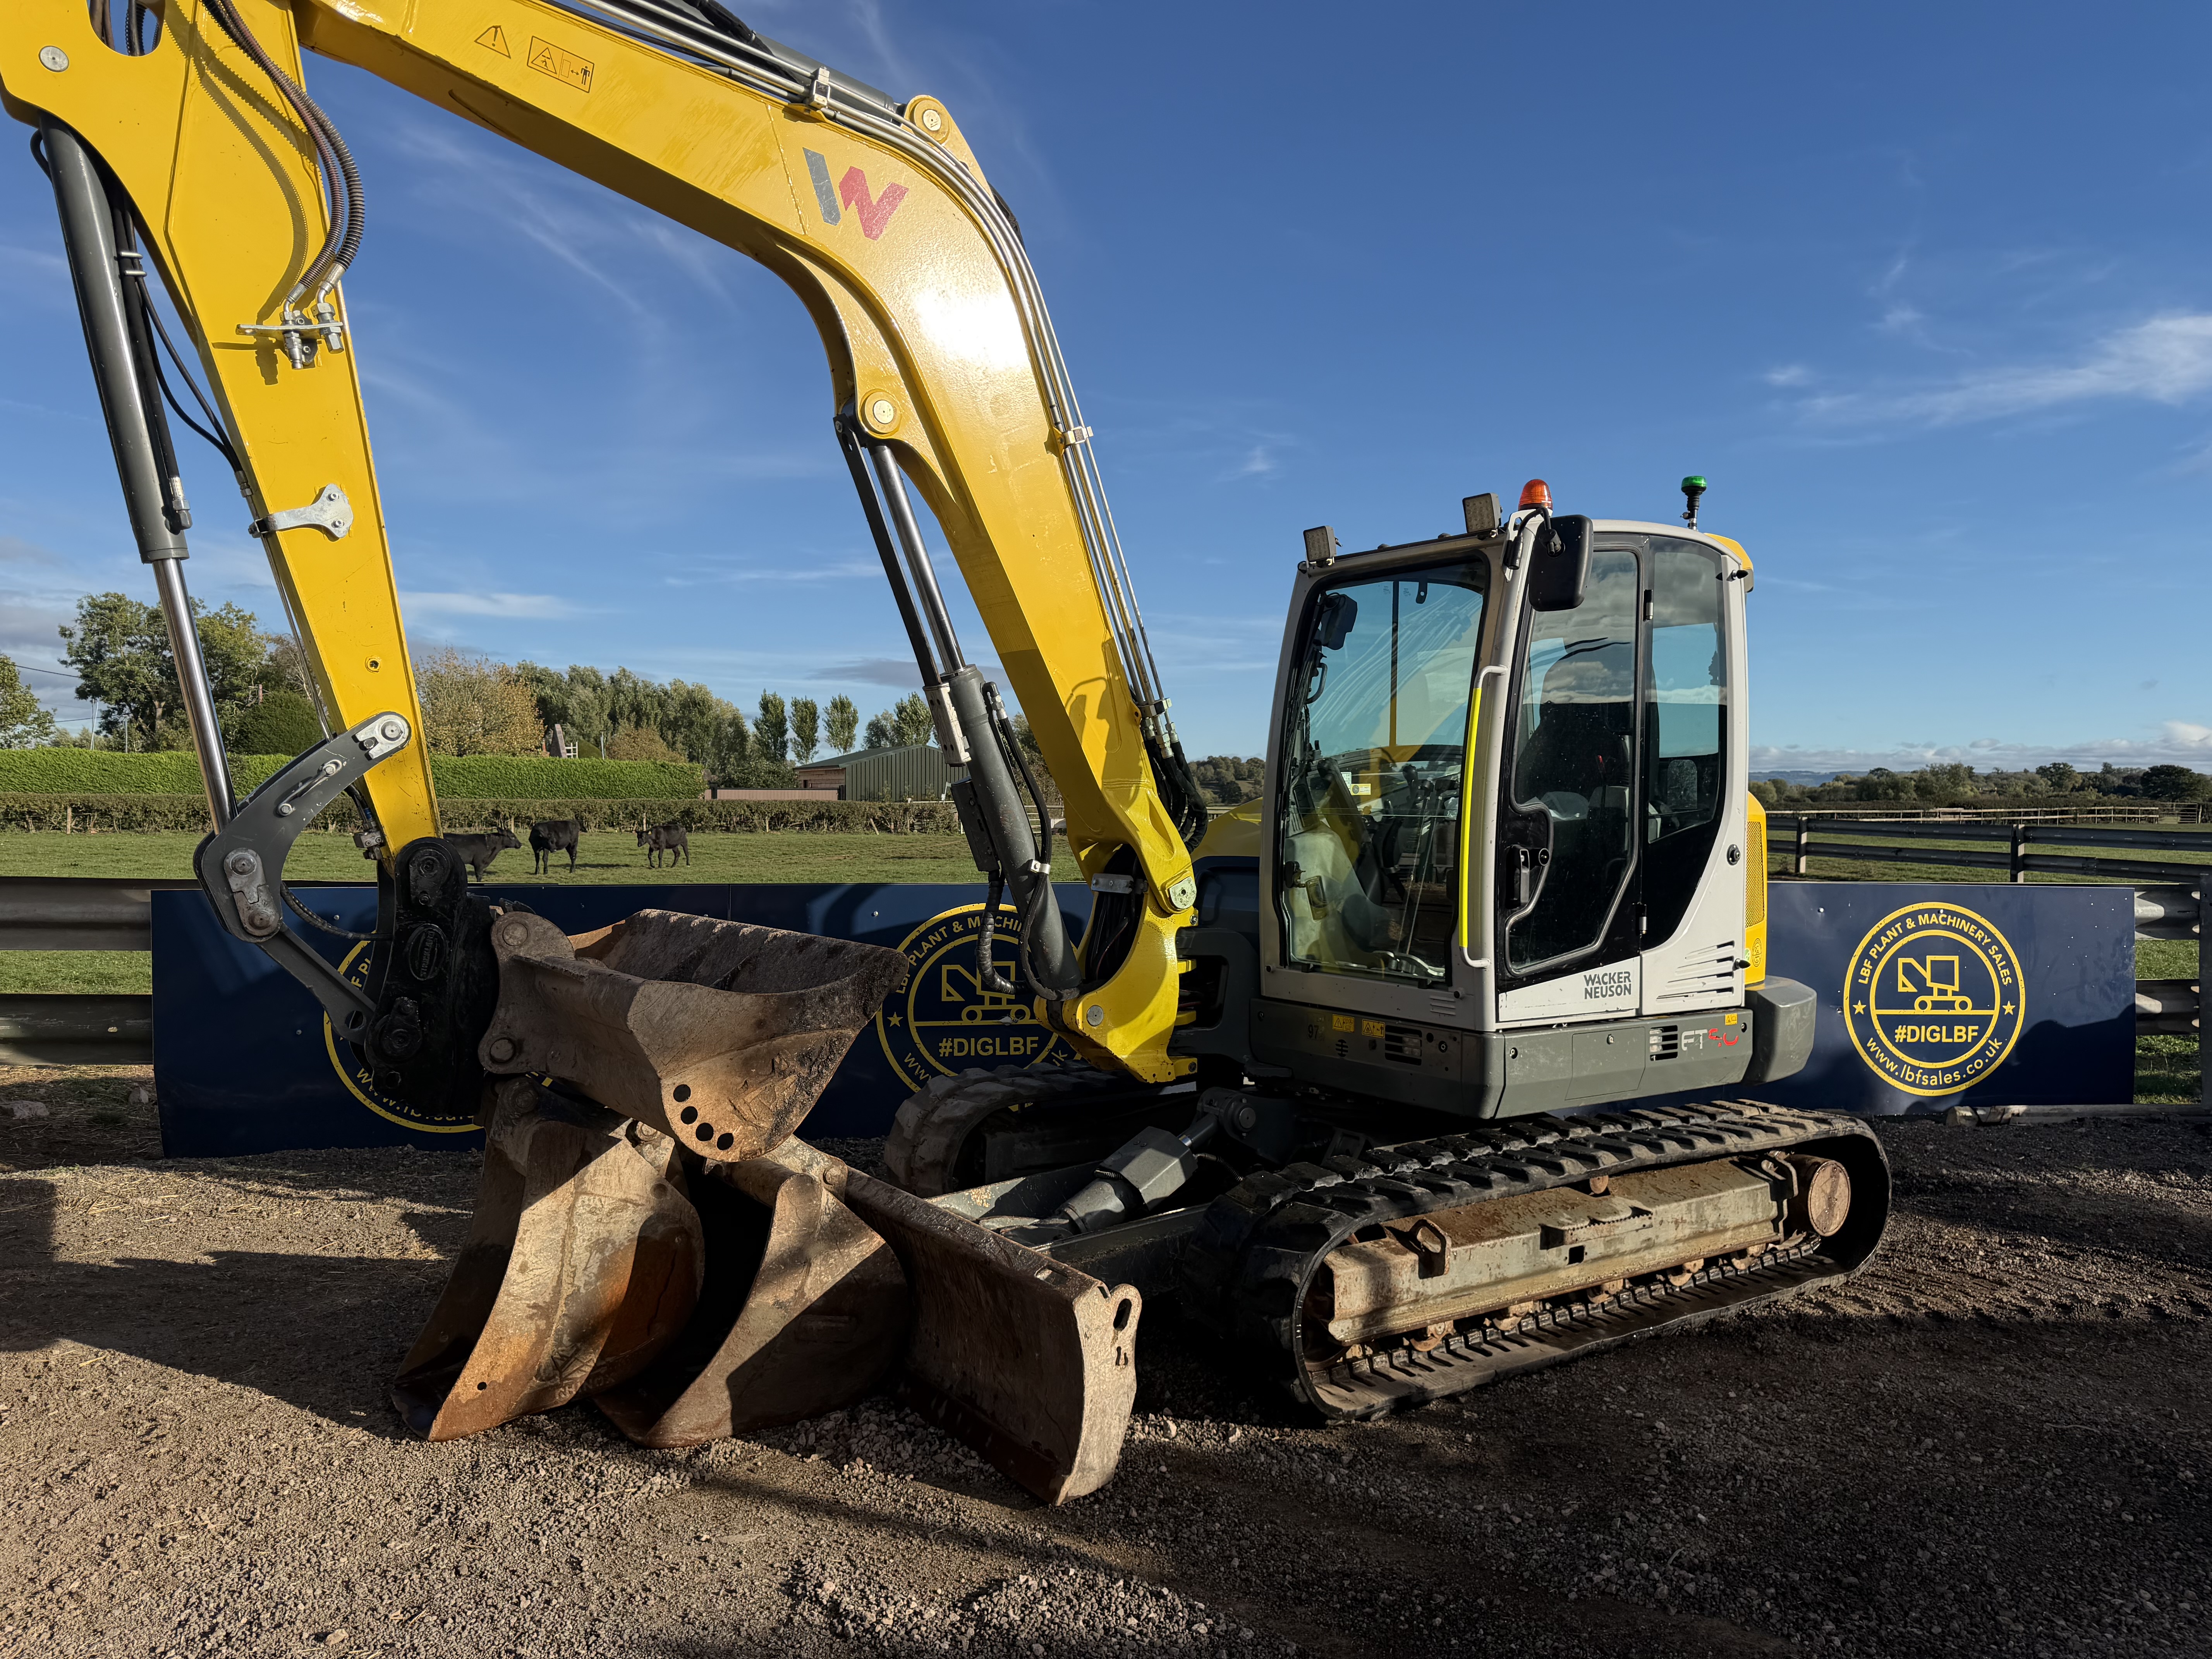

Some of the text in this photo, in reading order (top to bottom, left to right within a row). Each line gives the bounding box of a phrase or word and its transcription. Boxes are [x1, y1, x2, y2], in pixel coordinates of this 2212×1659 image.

[908, 926, 948, 966] PLANT
[952, 921, 963, 933] &
[1858, 913, 2012, 986] LBF PLANT & MACHINERY SALES
[1583, 971, 1632, 986] WACKER
[1584, 983, 1632, 1000] NEUSON
[1308, 1024, 1319, 1039] 97
[1895, 1025, 1979, 1043] #DIGLBF
[939, 1037, 1039, 1057] #DIGLBF
[1866, 1037, 2002, 1086] www.lbfsales.co.uk
